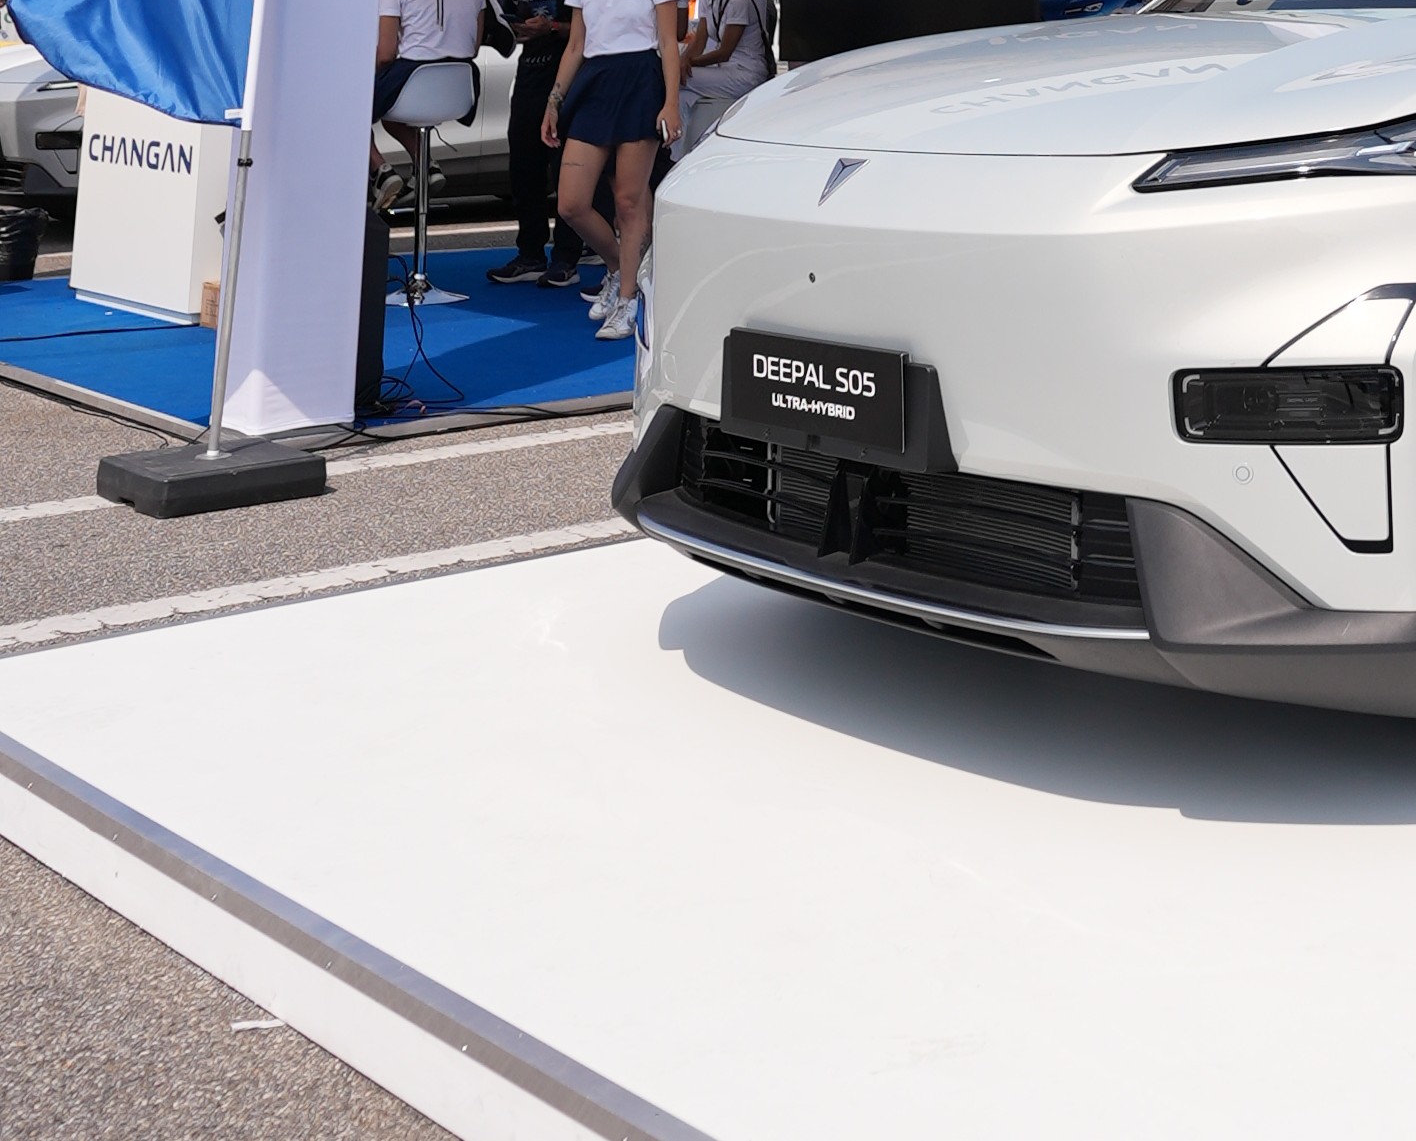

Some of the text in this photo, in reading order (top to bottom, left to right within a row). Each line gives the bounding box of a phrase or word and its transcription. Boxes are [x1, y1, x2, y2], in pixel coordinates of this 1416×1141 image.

[88, 133, 193, 176] CHANGAN
[753, 354, 876, 397] DEEPAL S05
[772, 393, 855, 420] ULTRA-HYBRID
